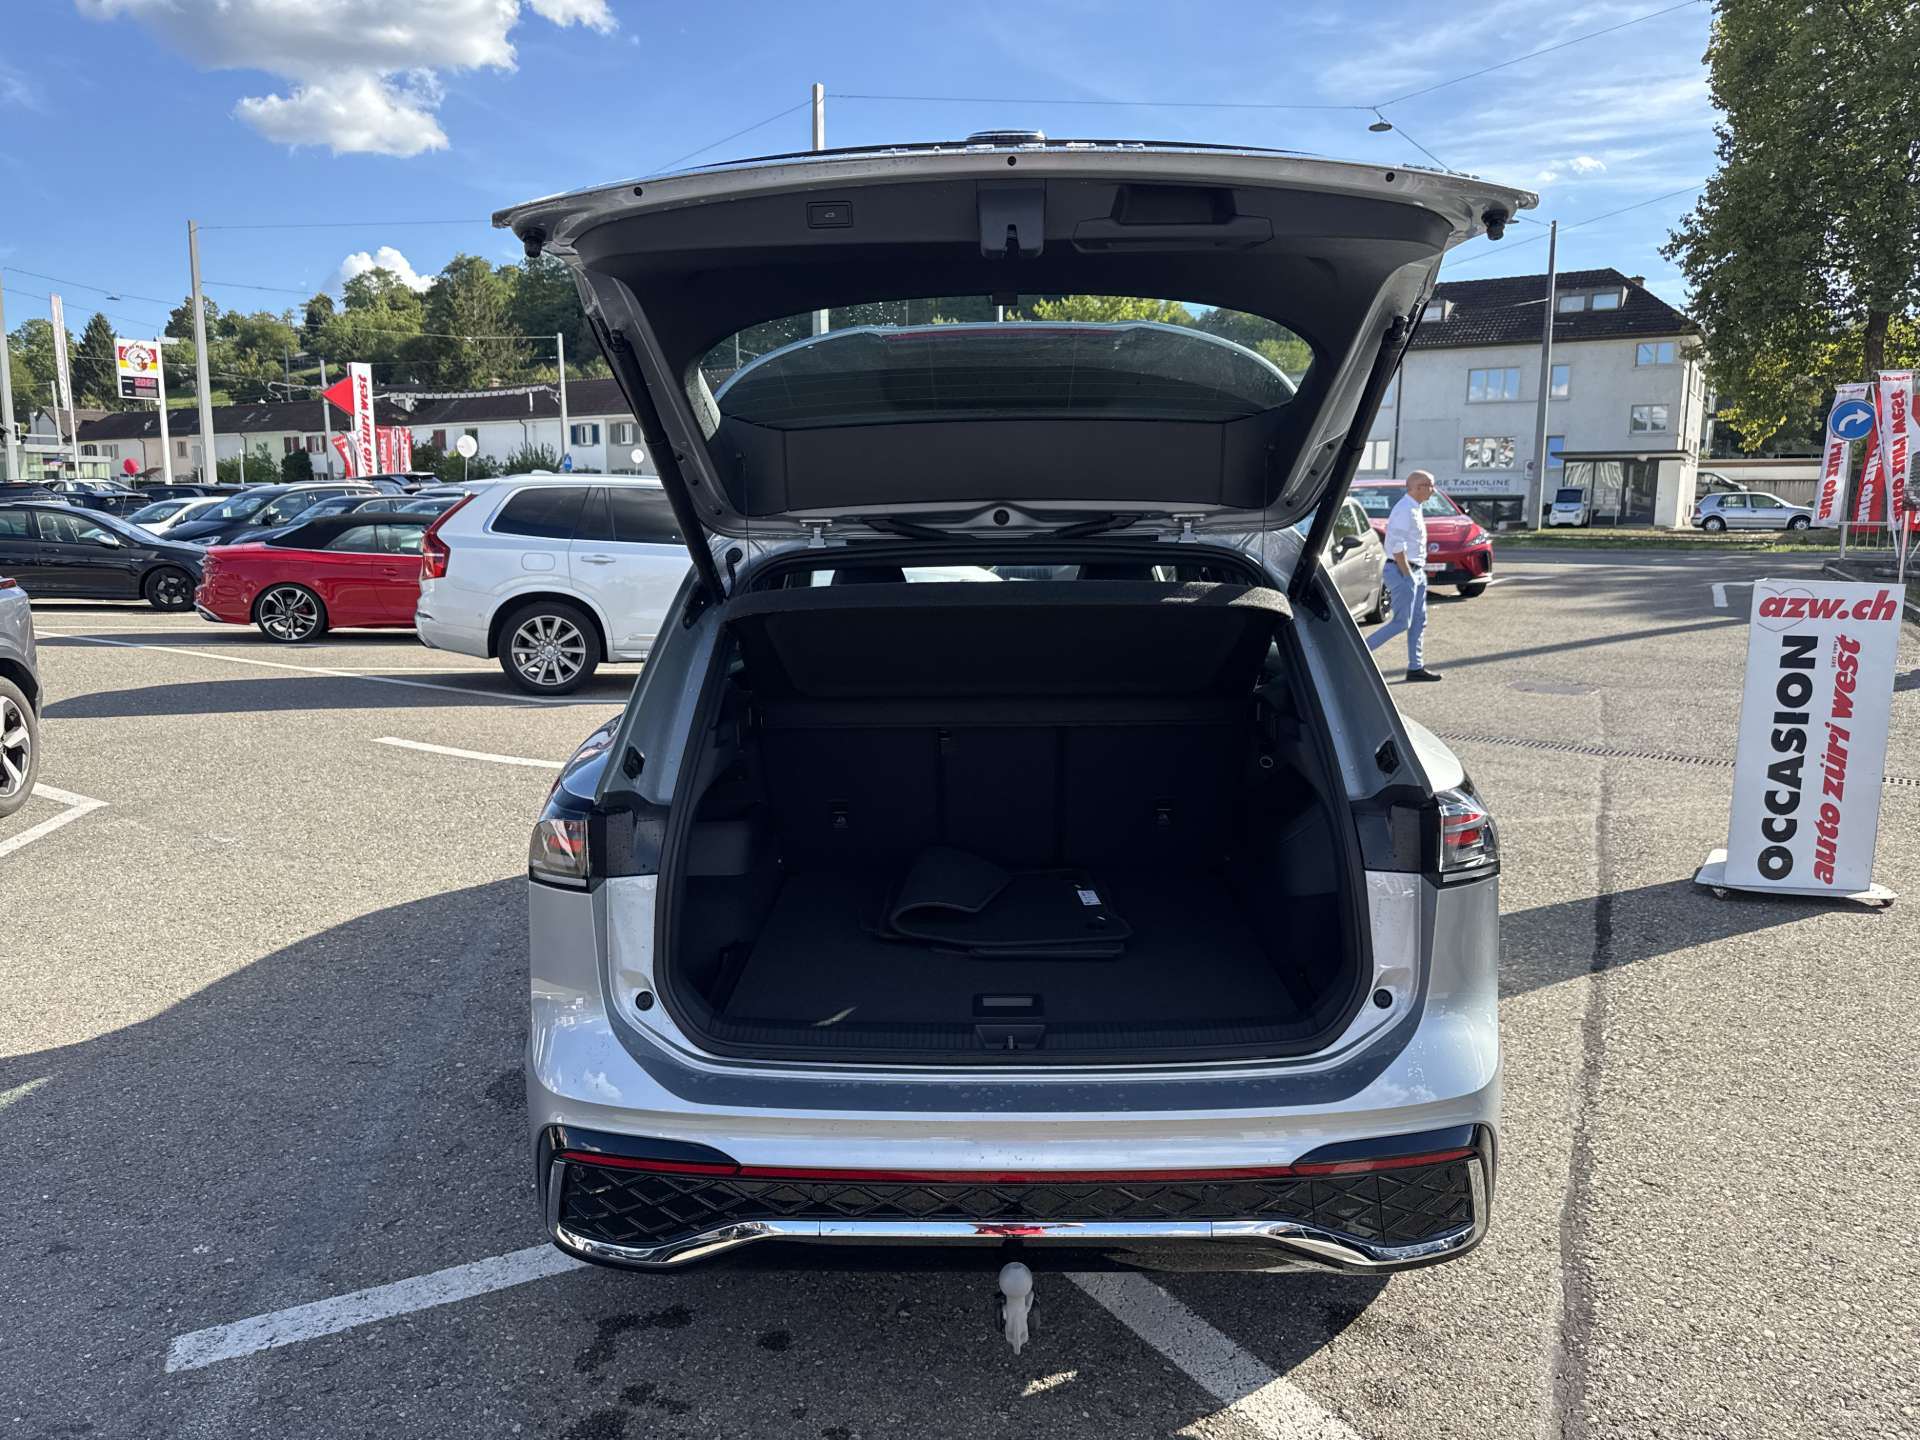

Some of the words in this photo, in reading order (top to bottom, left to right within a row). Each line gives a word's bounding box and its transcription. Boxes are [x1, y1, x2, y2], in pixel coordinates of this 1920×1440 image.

[358, 373, 370, 411] west
[1759, 589, 1898, 621] azw.ch
[1831, 633, 1861, 719] west
[1757, 635, 1819, 881] OCCASION
[1820, 722, 1851, 802] züri
[1813, 802, 1841, 885] auto
